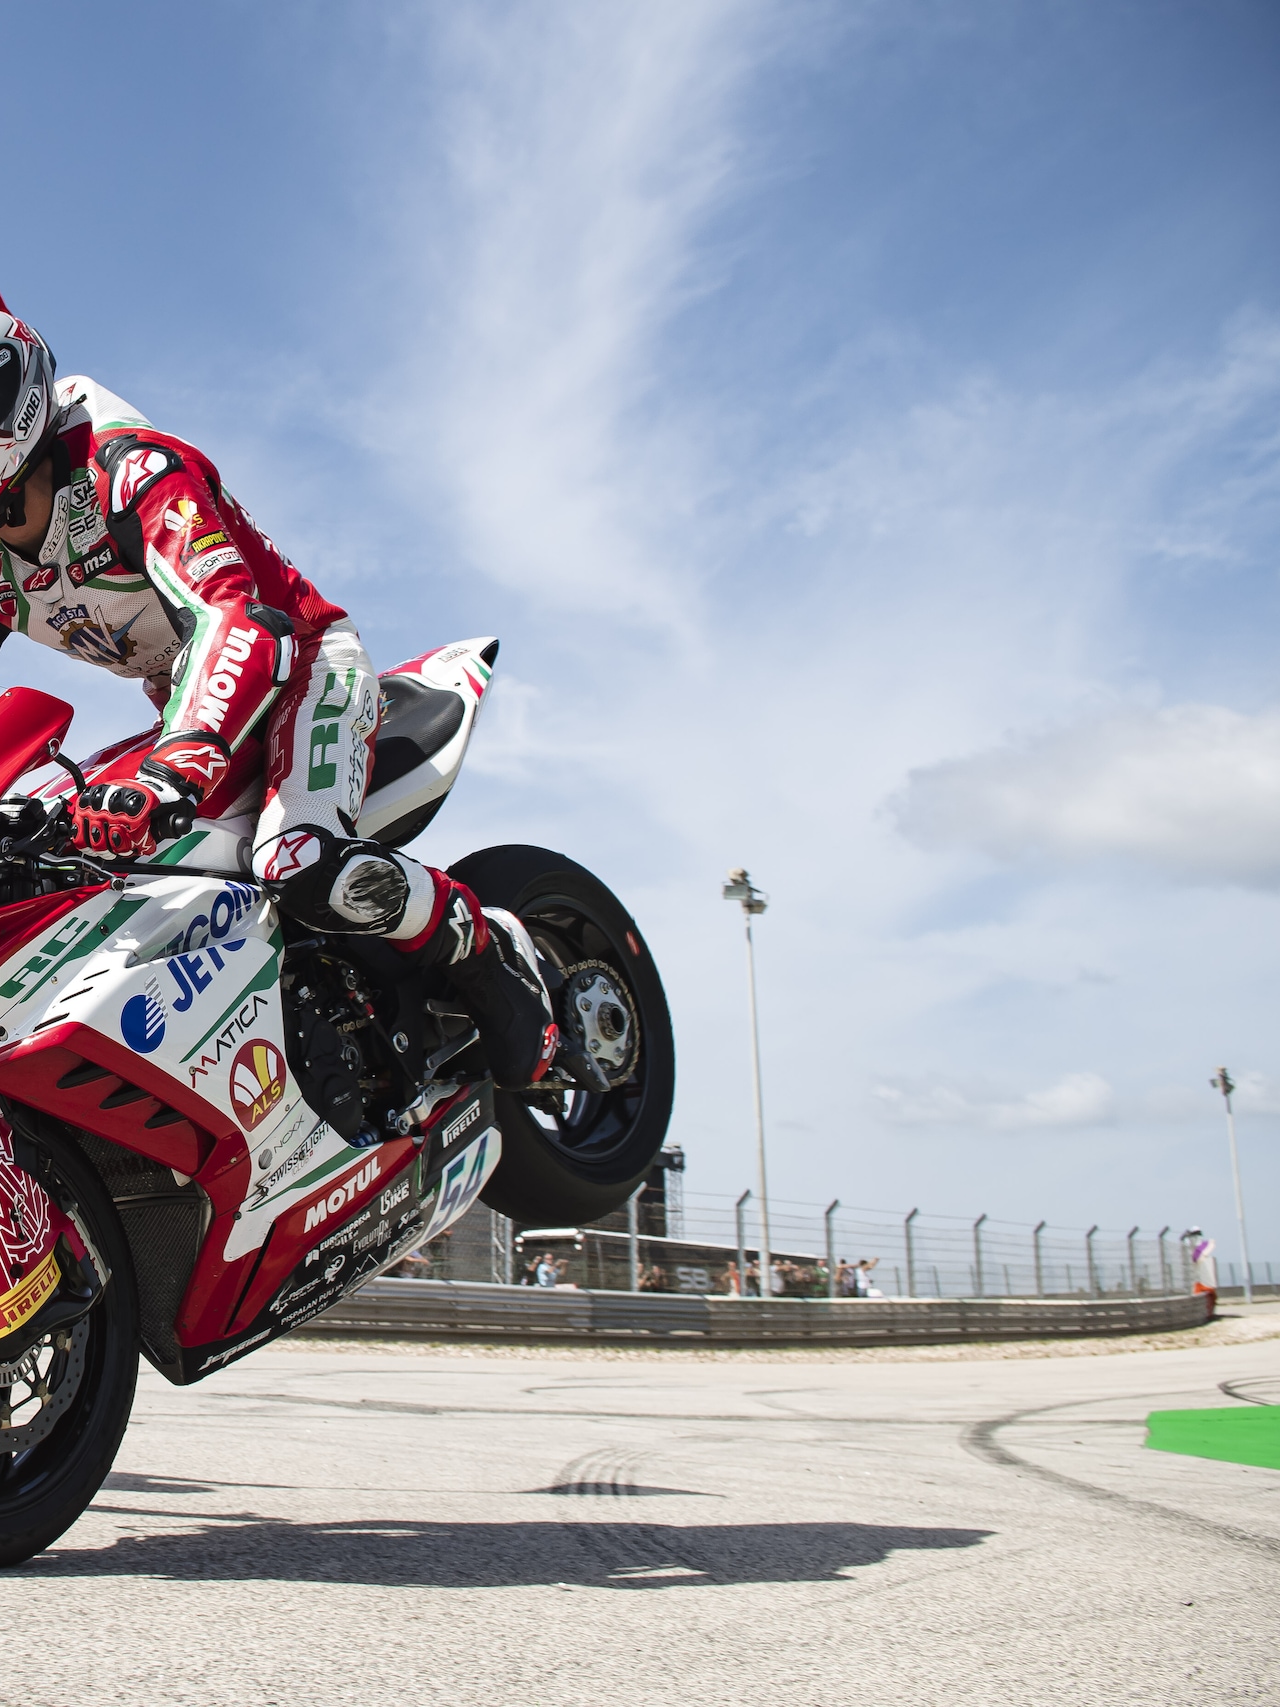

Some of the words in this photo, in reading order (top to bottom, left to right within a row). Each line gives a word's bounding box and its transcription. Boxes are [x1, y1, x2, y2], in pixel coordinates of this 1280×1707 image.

[17, 391, 41, 437] SHOEI
[83, 548, 113, 575] msi
[51, 608, 86, 629] AGUSTA
[145, 639, 181, 666] CORS
[196, 626, 259, 733] MOTUL
[250, 1080, 281, 1124] ALS
[442, 1099, 481, 1148] PIRELLI
[303, 1155, 382, 1234] MOTUL
[424, 1132, 489, 1242] 54
